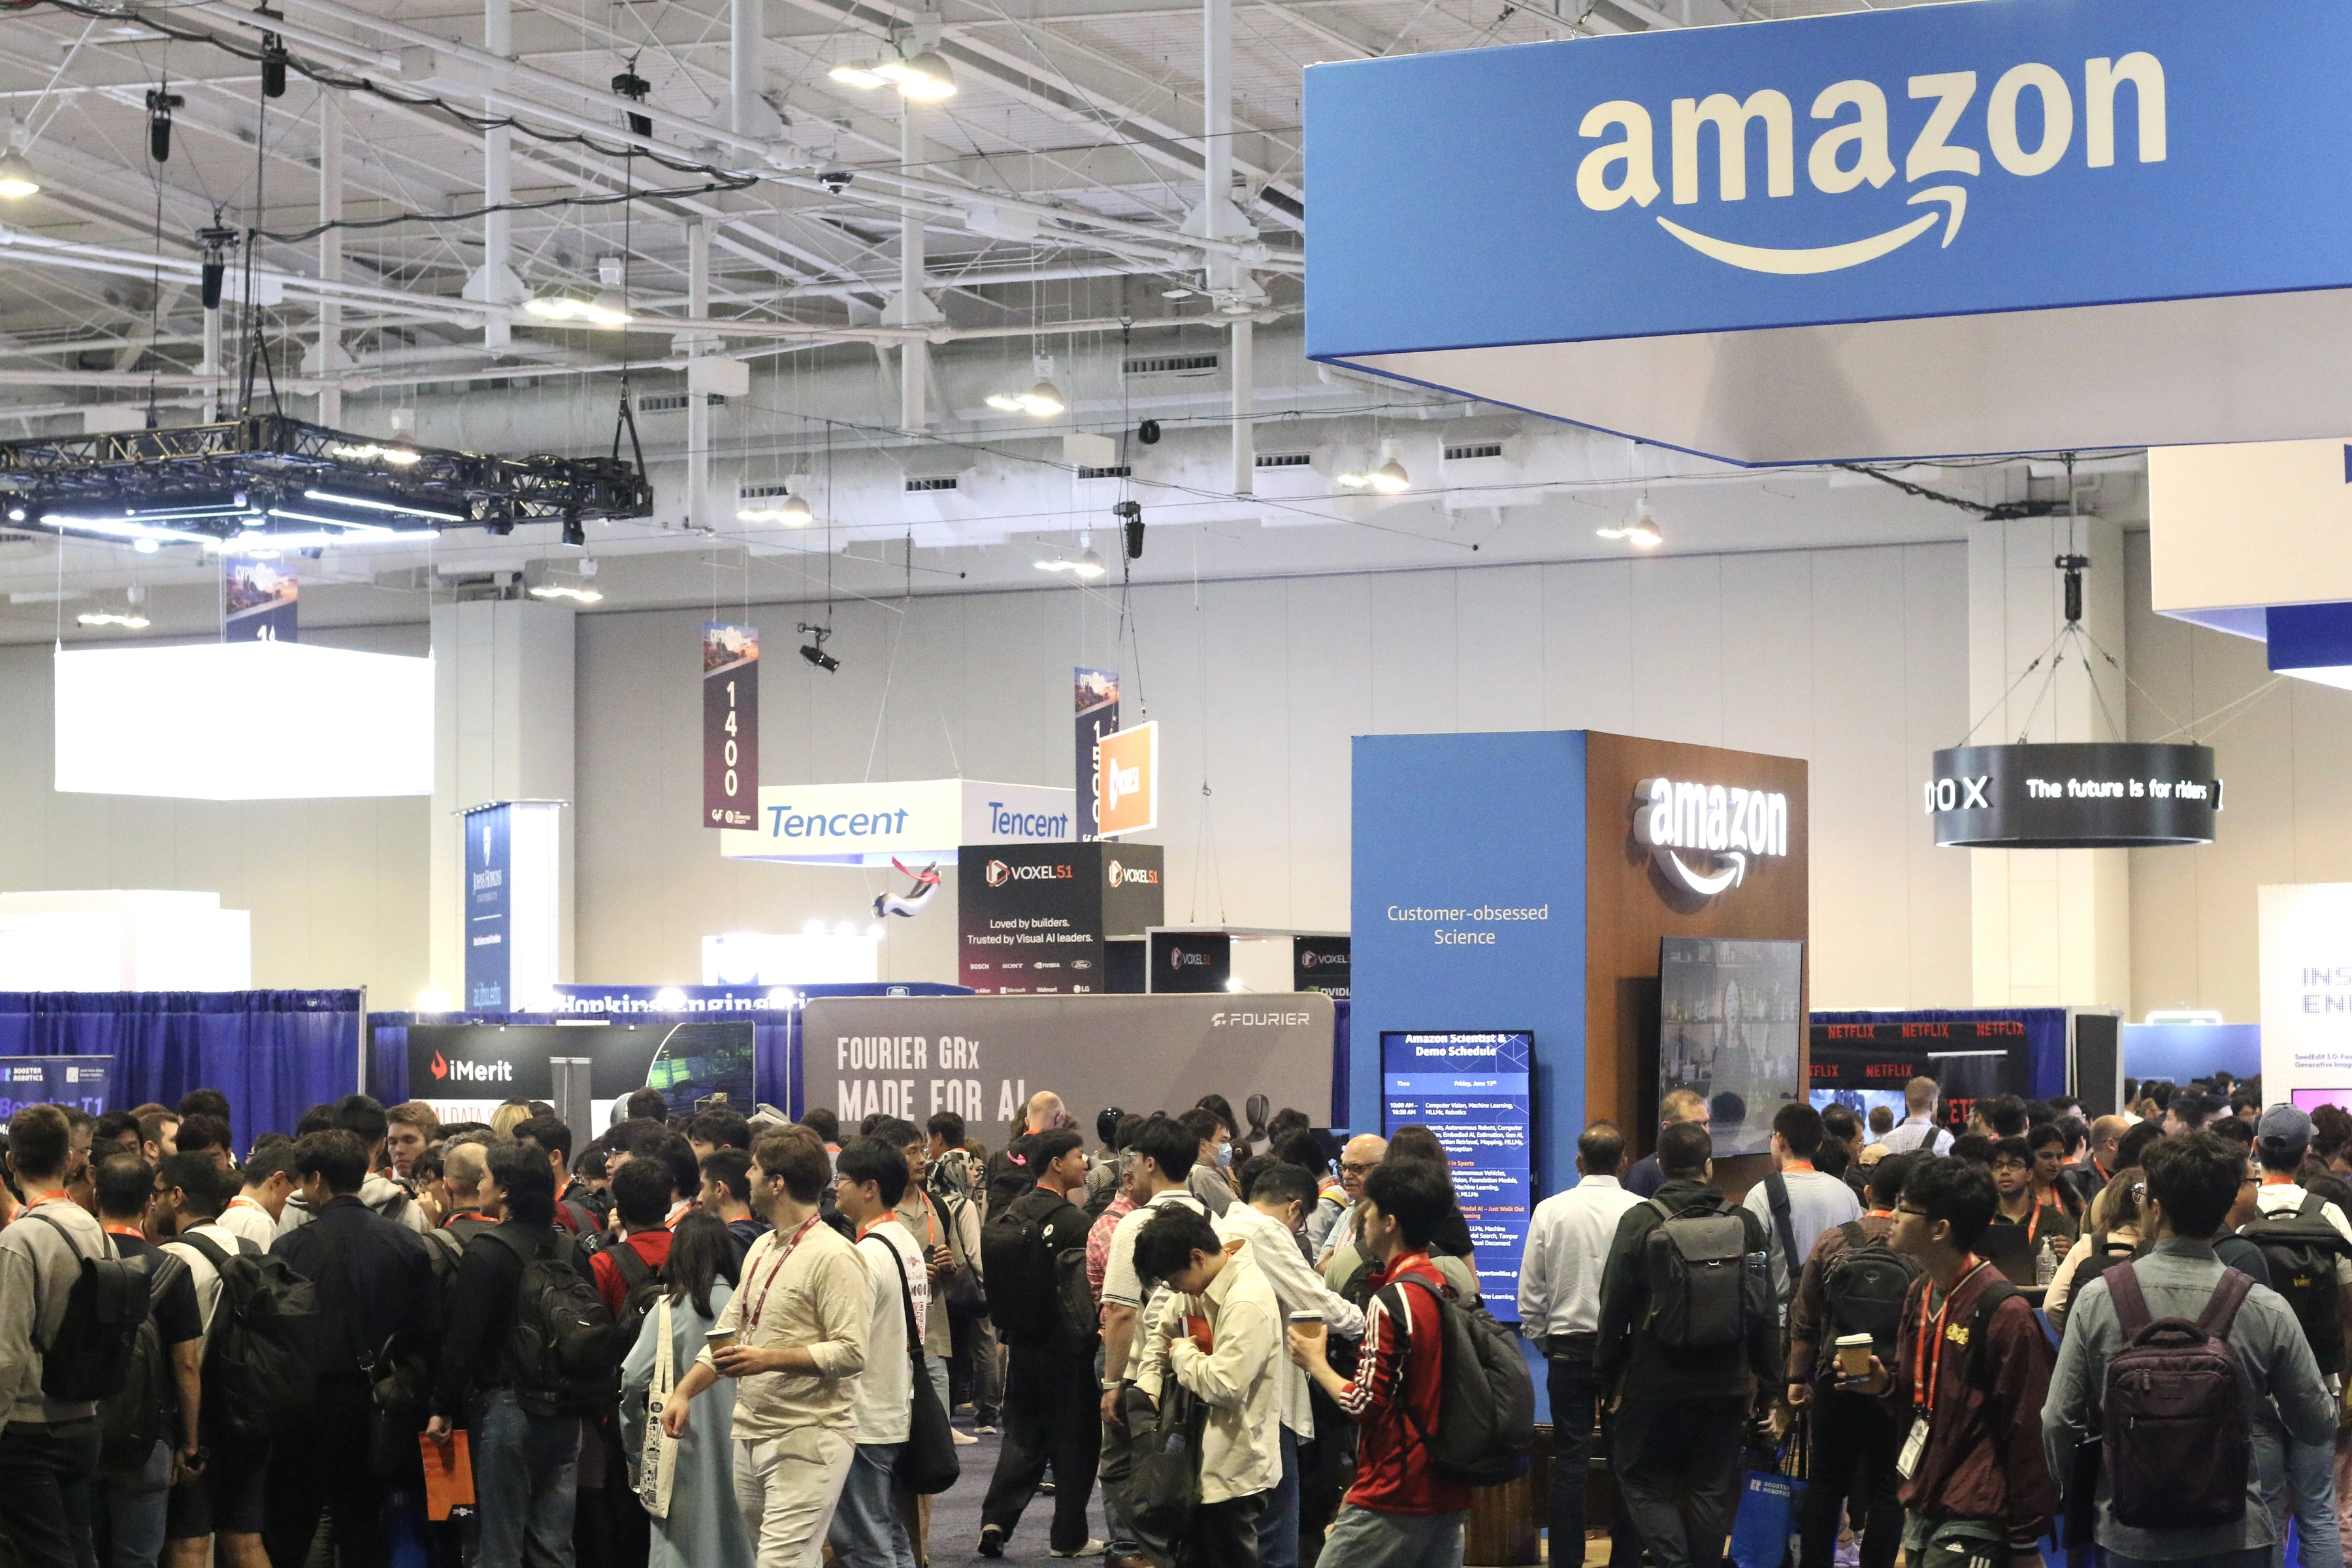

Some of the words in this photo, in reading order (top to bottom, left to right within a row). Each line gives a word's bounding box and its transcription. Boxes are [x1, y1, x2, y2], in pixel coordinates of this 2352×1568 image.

[1576, 51, 2168, 212] amazon
[725, 681, 738, 796] 1400
[2026, 779, 2062, 798] The
[2067, 778, 2124, 798] future
[2129, 778, 2144, 798] is
[2149, 779, 2172, 799] for
[2175, 780, 2208, 800] riders
[767, 806, 909, 838] Tencent
[988, 802, 1068, 840] Tencent
[1649, 777, 1788, 857] amazon
[1011, 864, 1073, 880] VOXEL51
[1123, 868, 1158, 883] VOXEL51
[1387, 904, 1549, 922] Customer-obsessed
[990, 919, 1015, 928] Loved
[1019, 919, 1030, 929] by
[1032, 917, 1070, 928] builders.
[967, 934, 1002, 944] Trusted
[1004, 934, 1014, 945] by
[1016, 934, 1044, 943] Visual
[1046, 933, 1055, 943] AI
[1057, 933, 1093, 943] leaders.
[1433, 928, 1495, 945] Science
[1183, 953, 1211, 965] VOXEL51
[1321, 987, 1350, 996] NVIDI
[559, 994, 662, 1013] Hopkins
[2302, 994, 2352, 1013] EN
[1230, 1013, 1309, 1026] FOURIER
[1405, 1034, 1448, 1043] Amazon
[1450, 1034, 1496, 1043] Scientist
[1497, 1034, 1507, 1043] &
[1829, 1024, 1874, 1039] NETFLIX
[1902, 1024, 1949, 1037] NETFLIX
[1976, 1022, 2024, 1037] NETFLIX
[838, 1036, 927, 1070] FOURIER
[1416, 1046, 1446, 1056] Demo
[1448, 1046, 1497, 1056] Schedule
[450, 1060, 512, 1081] iMerit
[1810, 1065, 1838, 1077] TFLIX
[1866, 1064, 1912, 1078] NETFLIX
[838, 1080, 915, 1121] MADE
[930, 1079, 982, 1121] FOR
[998, 1079, 1025, 1121] AI
